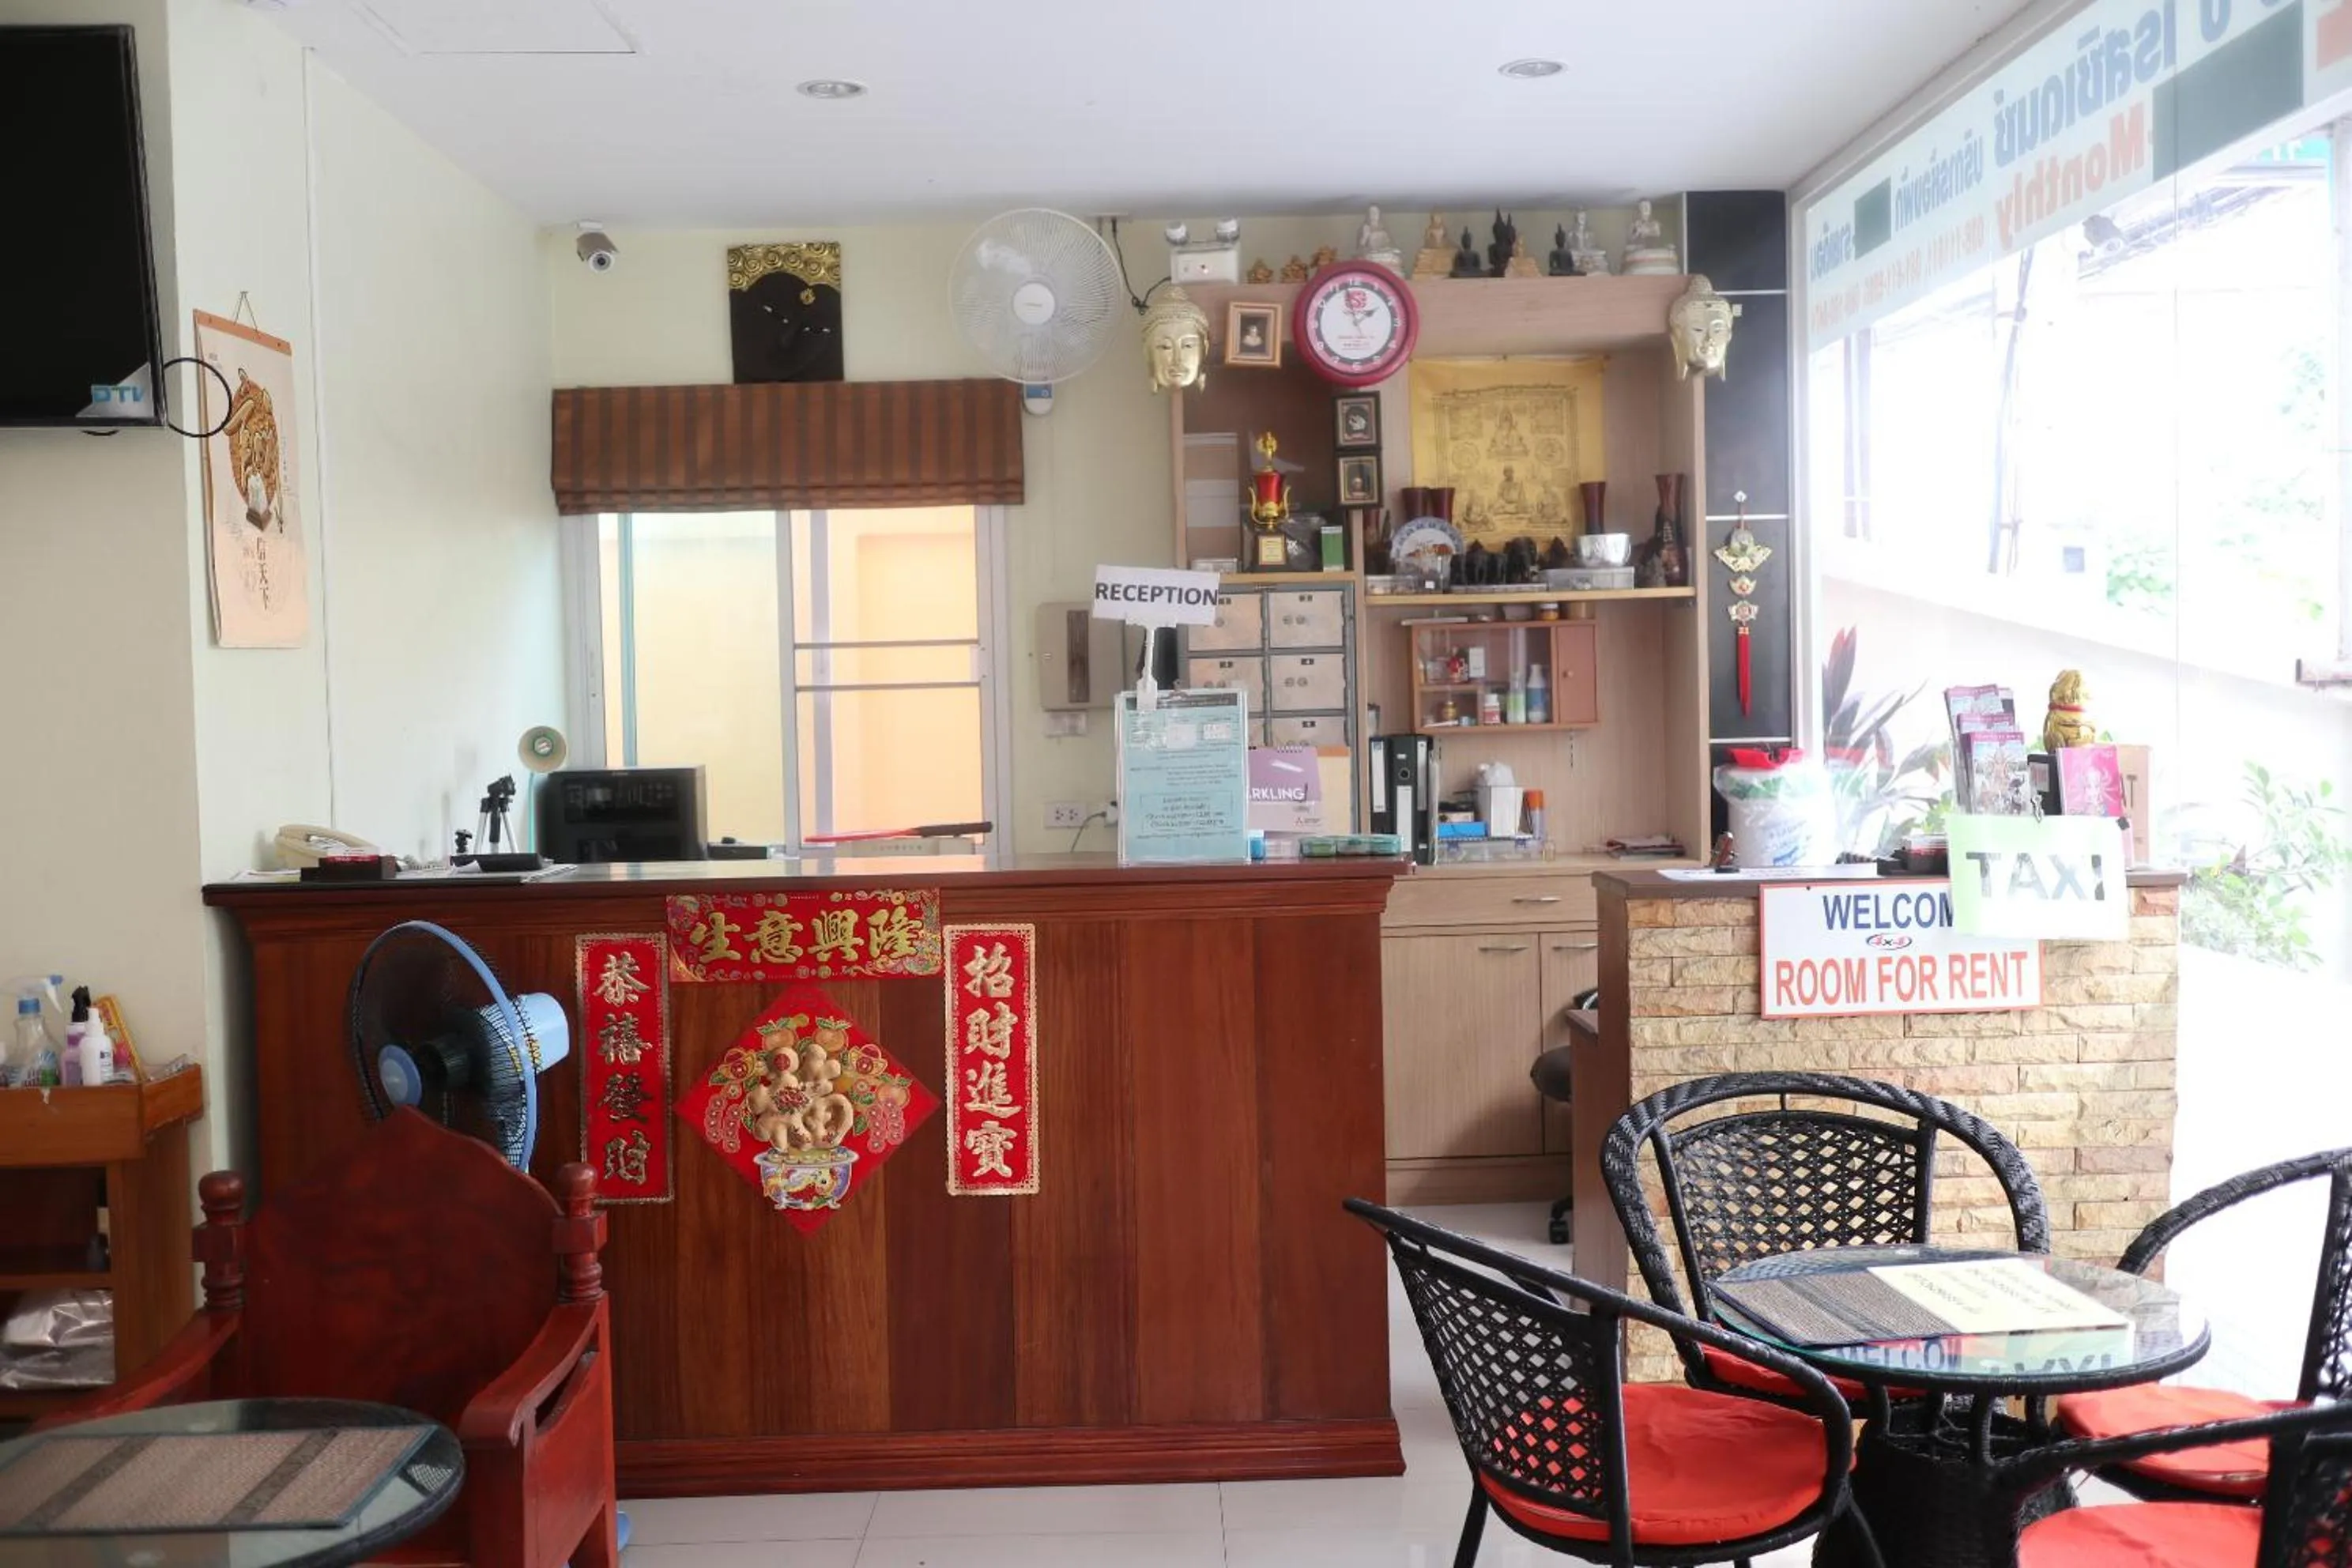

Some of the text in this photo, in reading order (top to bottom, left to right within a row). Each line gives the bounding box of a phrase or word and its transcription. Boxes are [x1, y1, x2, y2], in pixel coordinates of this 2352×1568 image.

[1095, 582, 1219, 606] RECEPTION
[1248, 788, 1306, 802] RKLING
[1966, 851, 2105, 901] TAXI
[689, 906, 923, 964] 生意興隆
[1822, 891, 1954, 931] WELCOM
[1775, 951, 2028, 1007] ROOM FOR RENT
[593, 951, 654, 1185] 恭禧發財
[963, 941, 1023, 1178] 招財進寶
